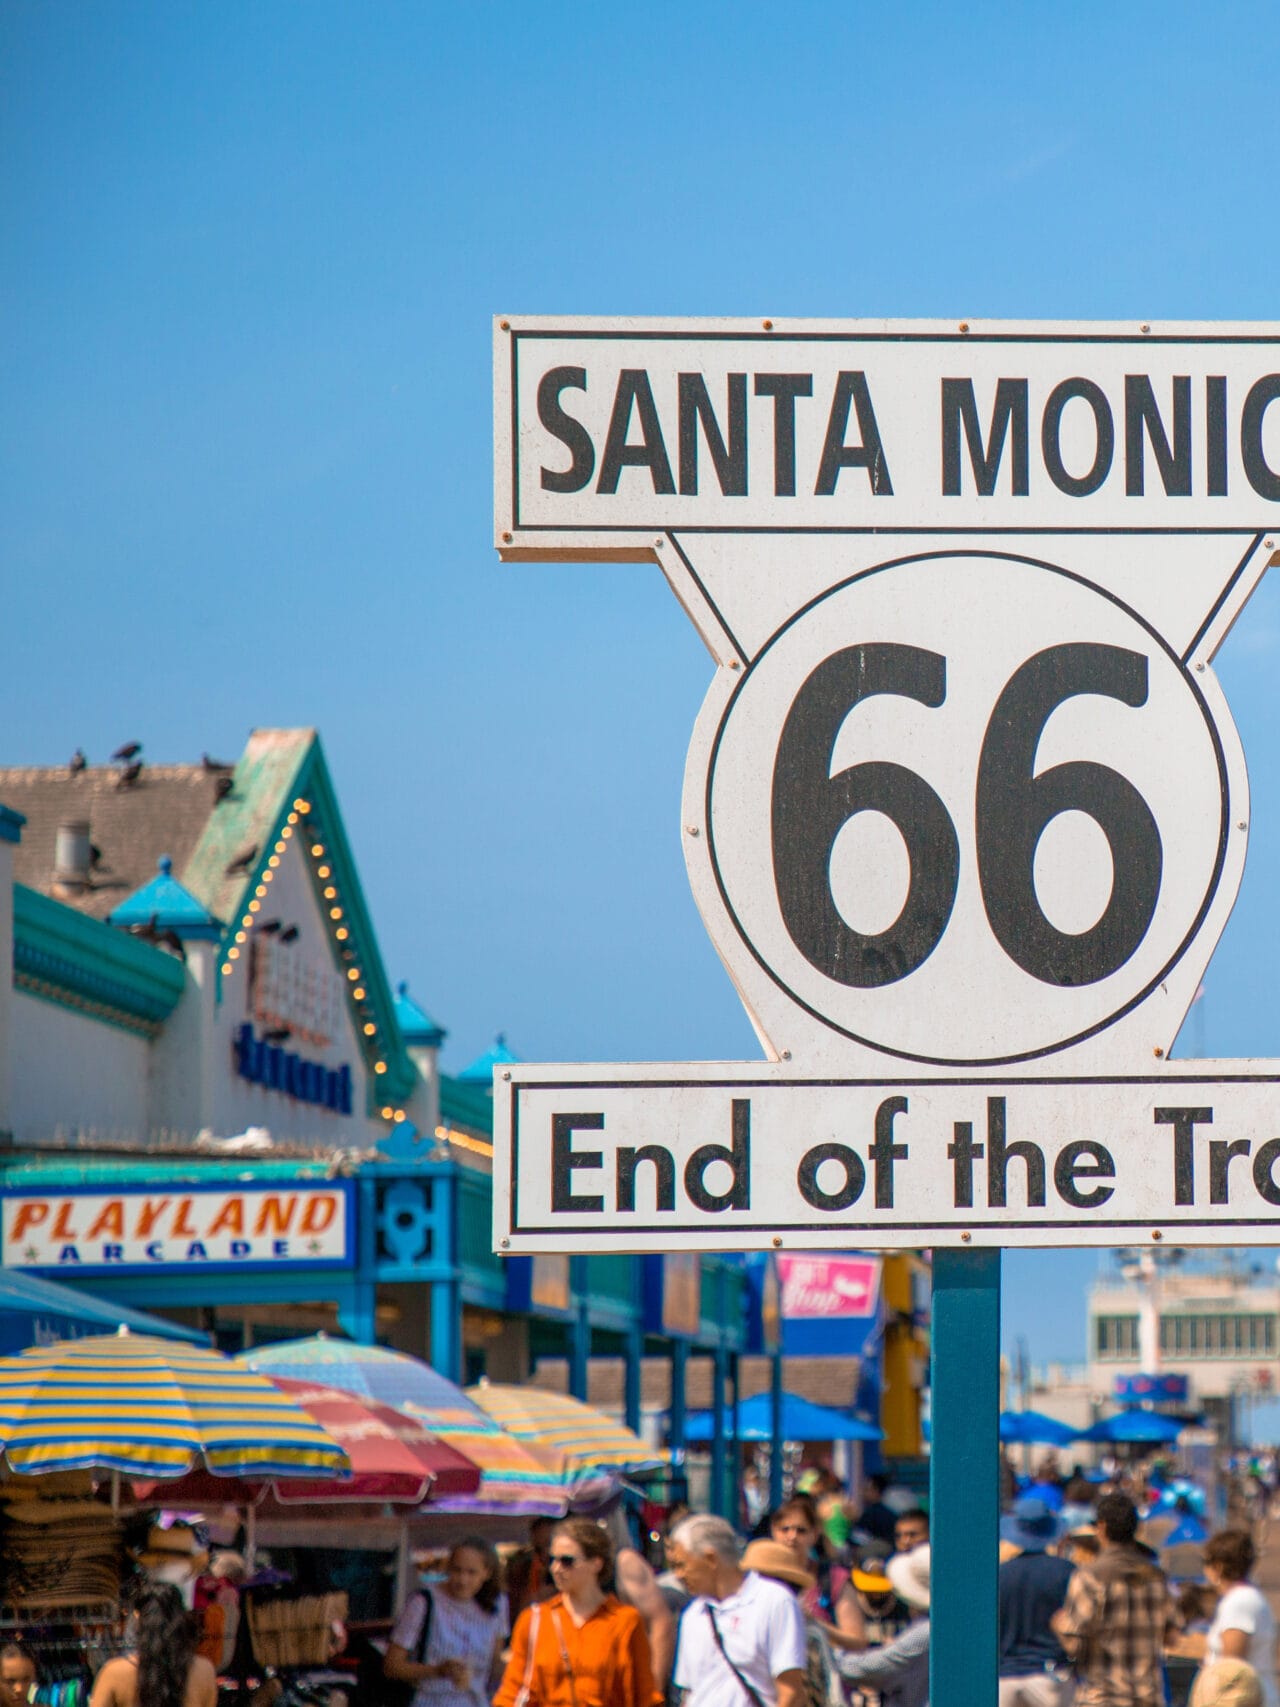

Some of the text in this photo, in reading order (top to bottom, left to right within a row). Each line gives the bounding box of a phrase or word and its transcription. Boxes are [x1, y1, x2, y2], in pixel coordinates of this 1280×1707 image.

[537, 366, 895, 497] SANTA
[771, 642, 1163, 988] 66
[551, 1099, 751, 1213] End
[797, 1095, 909, 1211] of
[947, 1096, 1116, 1209] the
[8, 1190, 339, 1243] PLAYLAND
[58, 1239, 290, 1264] ARCADE
